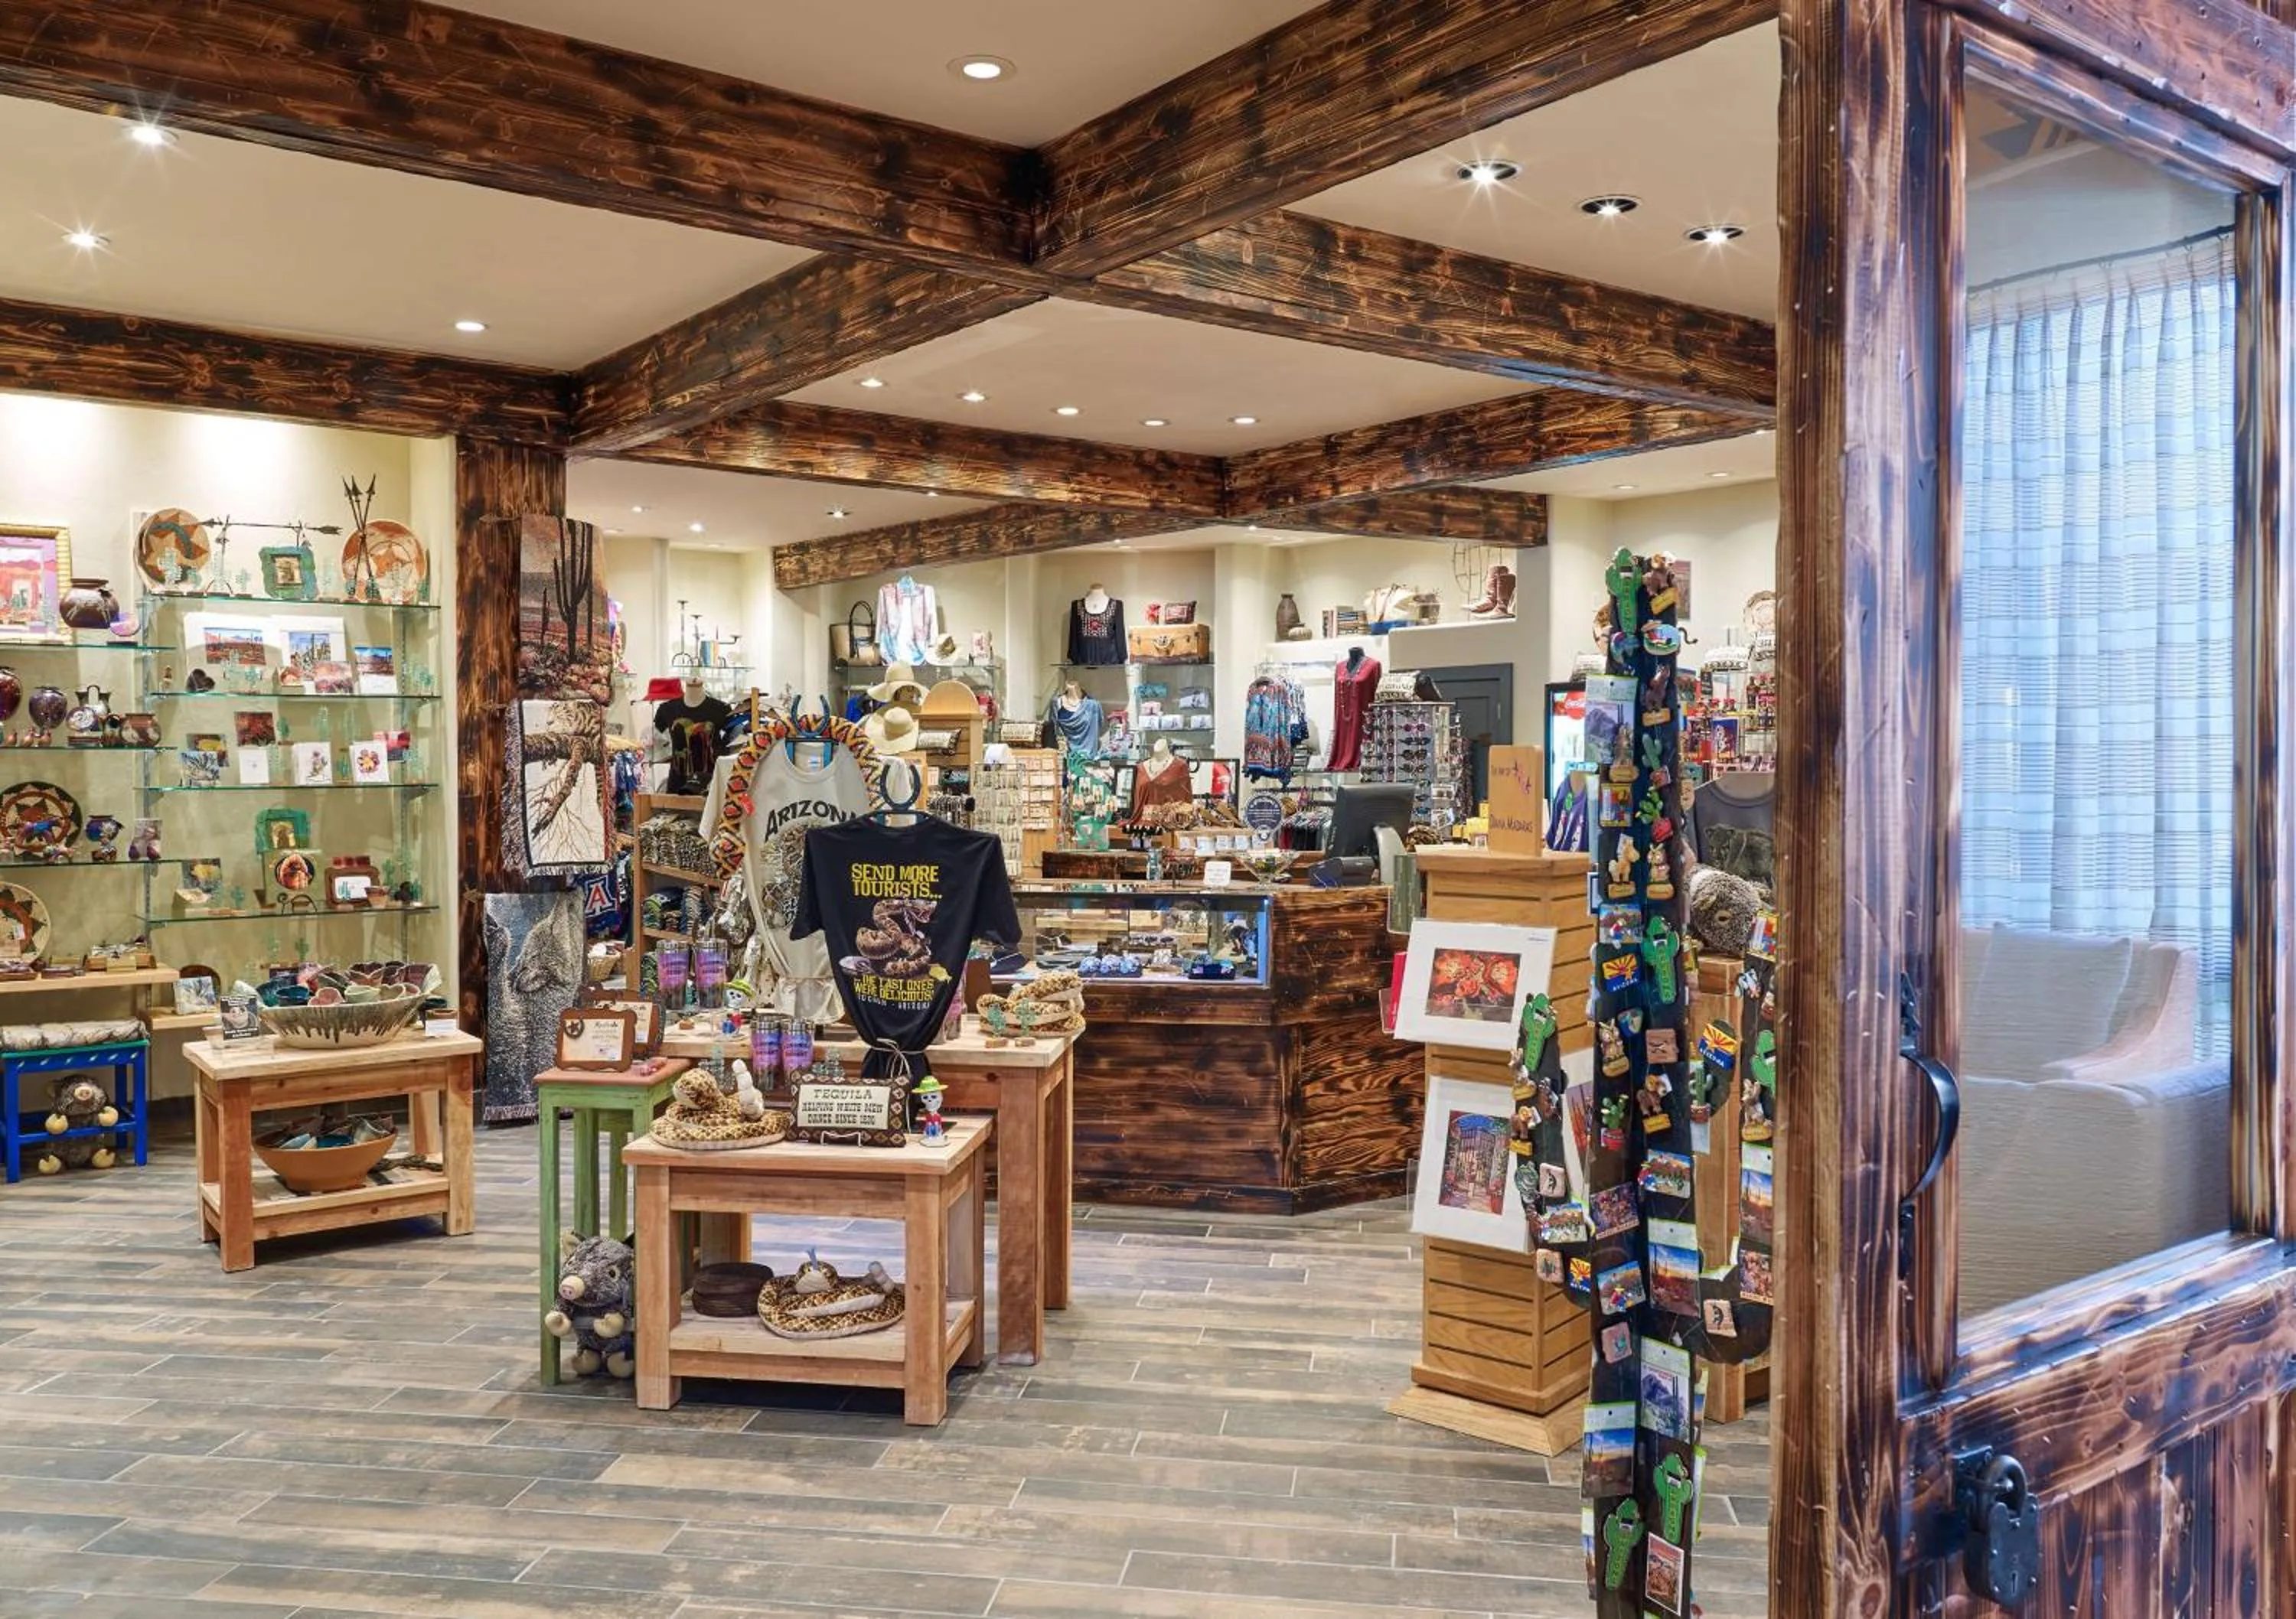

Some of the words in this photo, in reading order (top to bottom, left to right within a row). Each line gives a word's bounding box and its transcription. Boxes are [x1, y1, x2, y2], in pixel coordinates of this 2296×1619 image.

[765, 800, 857, 842] ARIZON
[851, 862, 895, 881] SEND
[899, 865, 940, 882] MORE
[853, 880, 942, 898] TOURISTS...
[907, 979, 934, 992] ONES
[813, 1088, 872, 1099] TEQUILA
